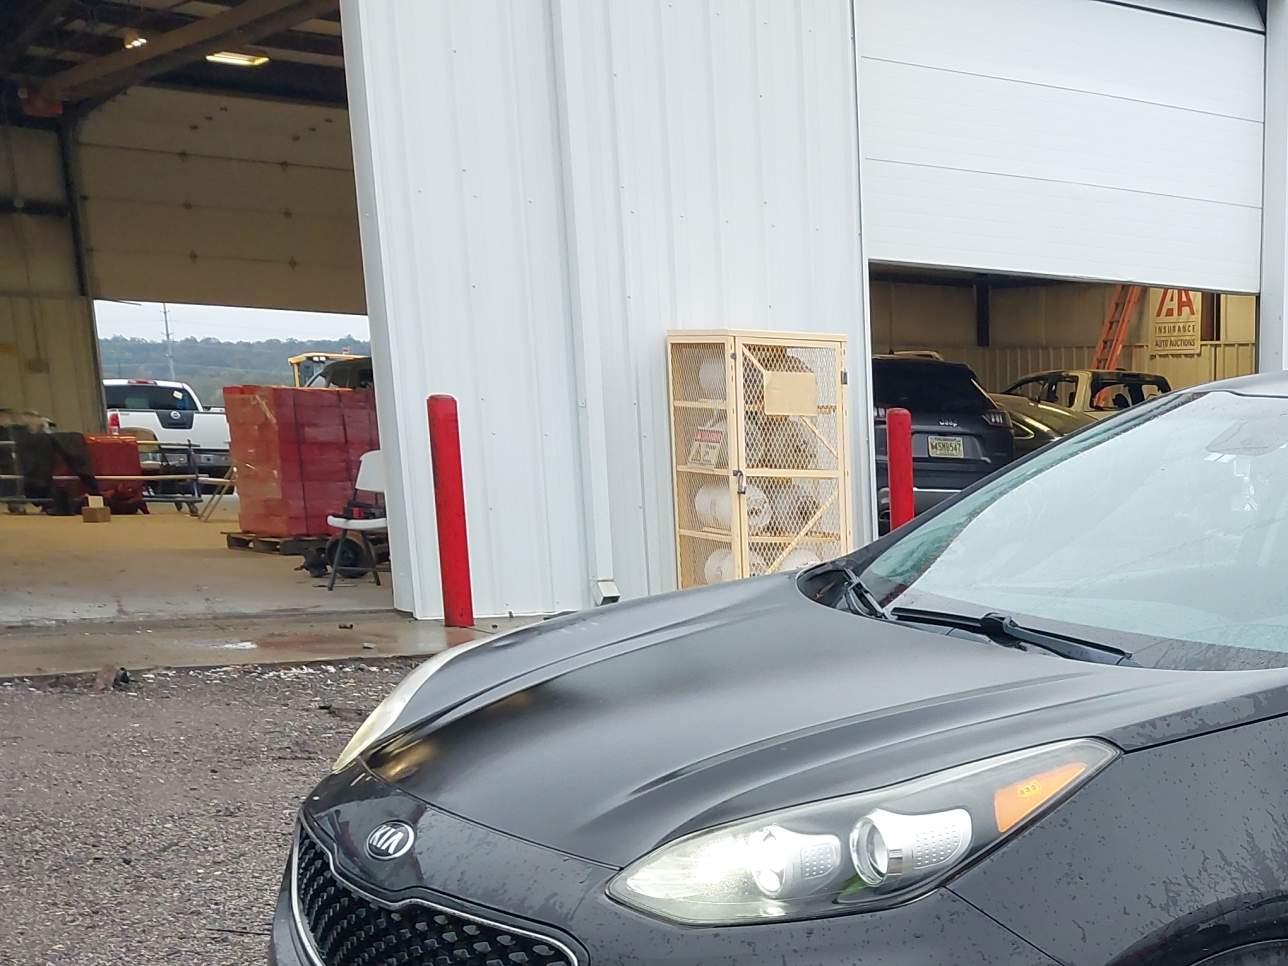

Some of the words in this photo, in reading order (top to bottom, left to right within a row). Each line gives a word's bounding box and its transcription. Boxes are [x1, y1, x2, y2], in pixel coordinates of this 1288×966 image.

[1154, 324, 1196, 334] INSURANCE
[1154, 339, 1169, 348] AUTO
[1169, 338, 1196, 348] AUCTIONS
[369, 824, 405, 855] KIA
